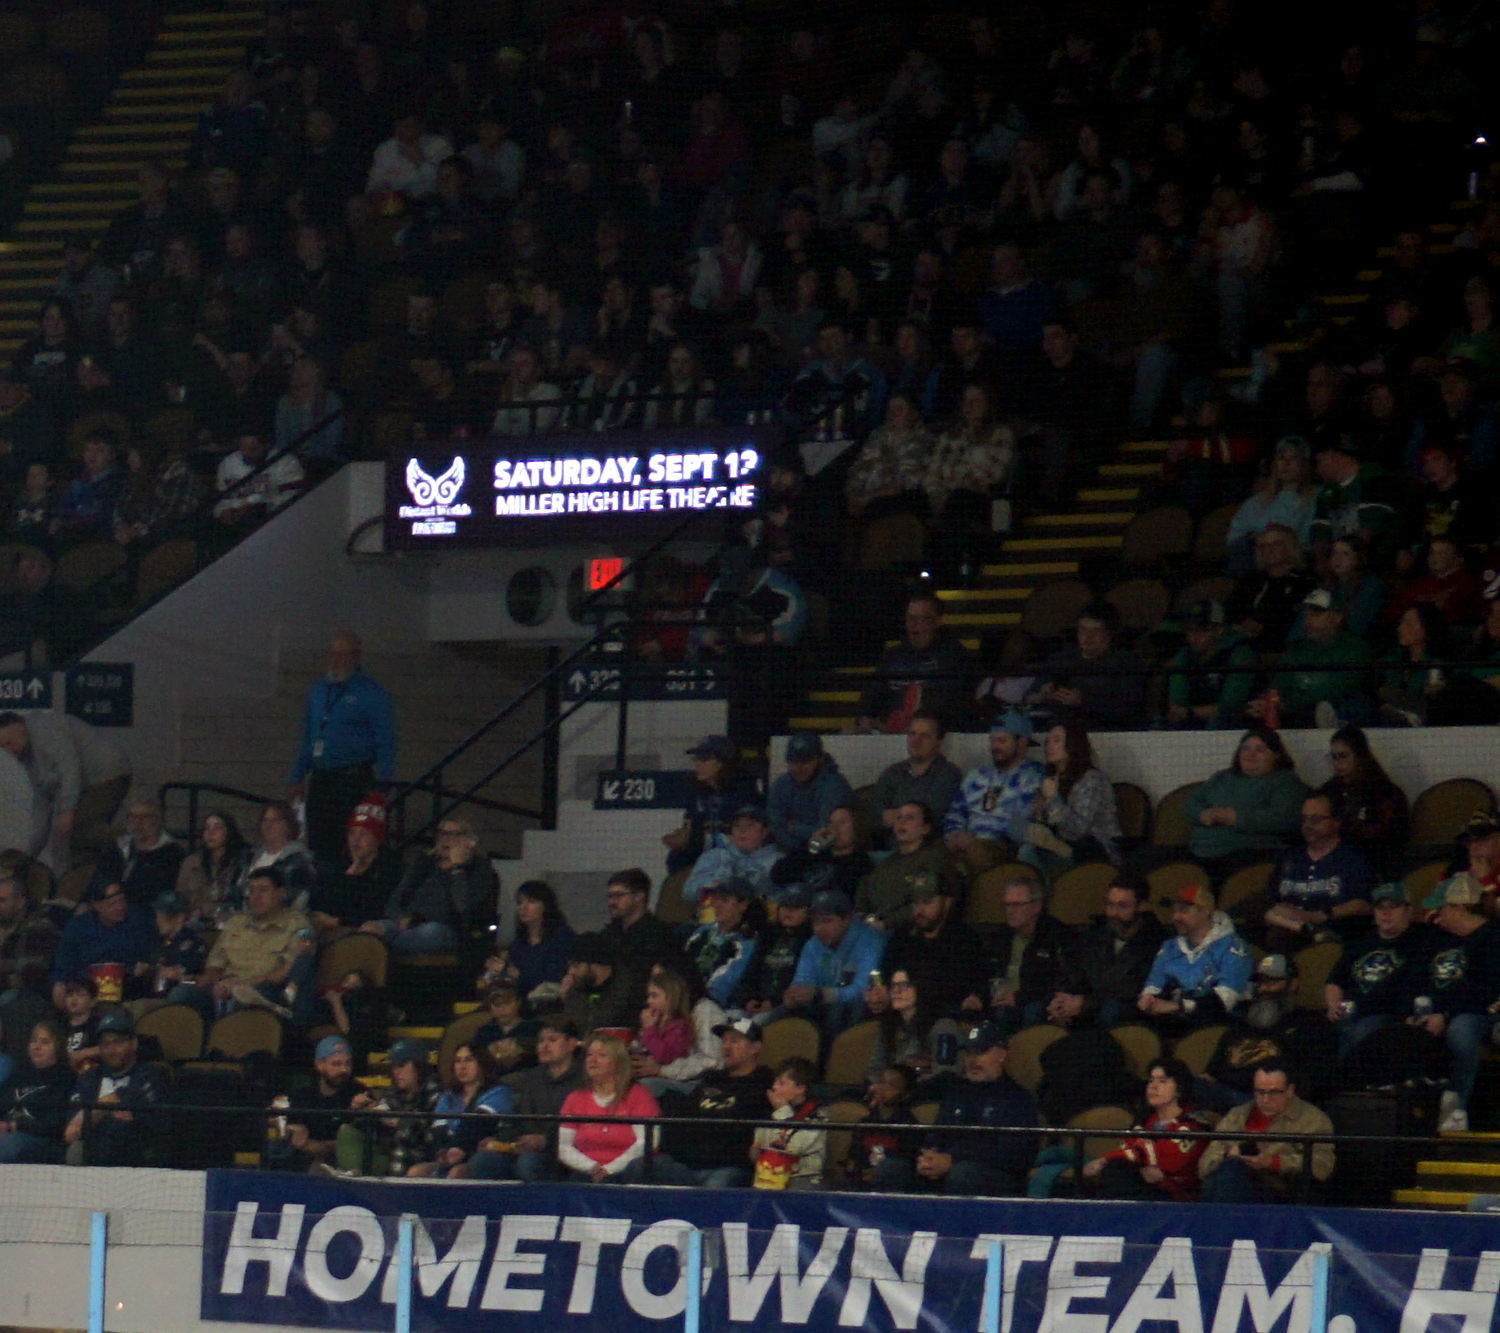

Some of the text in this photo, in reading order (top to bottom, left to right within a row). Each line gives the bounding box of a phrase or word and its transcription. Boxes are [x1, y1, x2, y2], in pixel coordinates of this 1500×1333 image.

[494, 457, 642, 489] SATURDAY,
[647, 453, 718, 482] SEPT
[496, 491, 564, 517] MILLER
[567, 488, 617, 513] HIGH
[622, 488, 664, 511] LIFE
[623, 779, 654, 800] 230
[218, 1202, 928, 1328] HOMETOWN
